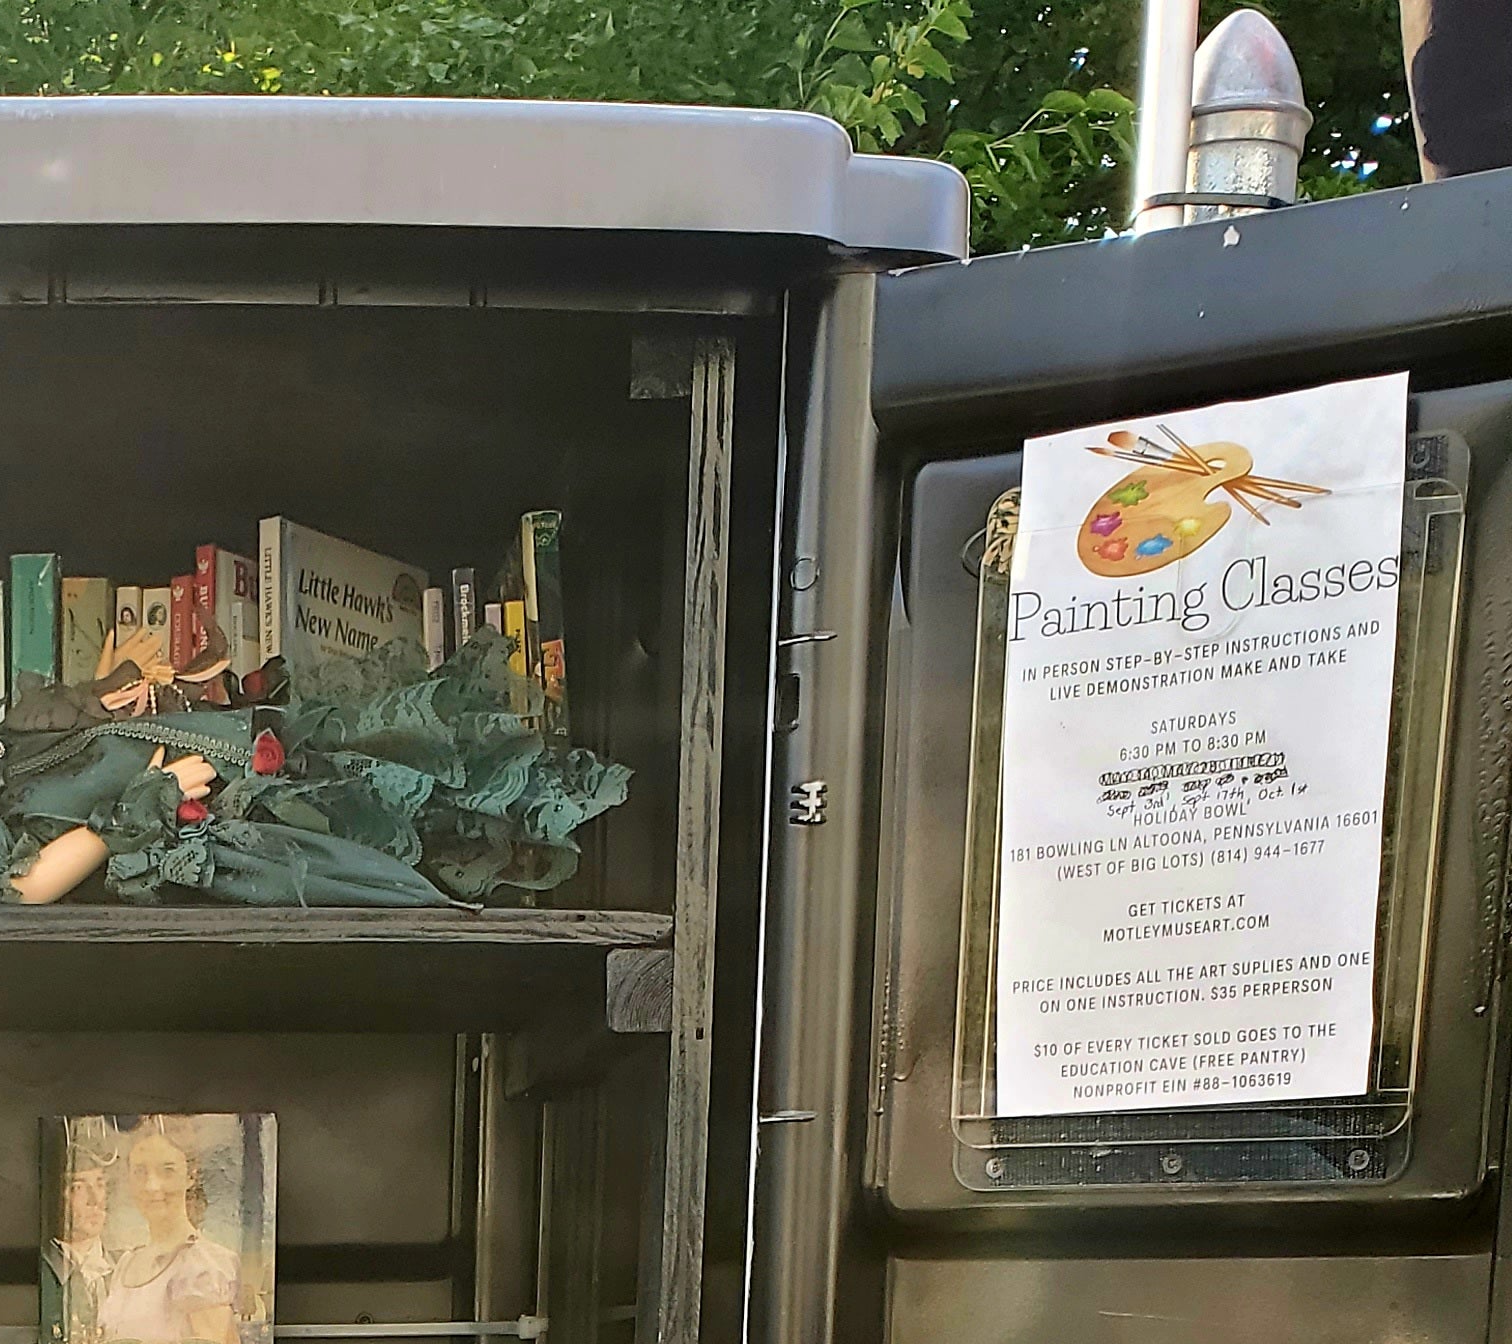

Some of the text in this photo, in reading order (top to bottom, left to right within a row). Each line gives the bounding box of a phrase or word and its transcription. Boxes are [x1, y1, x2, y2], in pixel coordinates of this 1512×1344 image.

[264, 547, 273, 653] LITTLE HAWK'S NEW
[299, 568, 337, 605] Little
[342, 584, 393, 624] Hawk's
[1009, 555, 1399, 642] Painting Classes
[295, 605, 378, 650] New Name
[1022, 621, 1380, 682] IN PERSON STEP-BY-STEP INSTRUCTIONS AND
[1049, 649, 1347, 701] LIVE DEMONSTRATION MAKE AND TAKE
[1151, 711, 1237, 734] SATURDAYS
[1120, 729, 1266, 761] 6:30 PM TO 8:30 PM
[1134, 803, 1247, 826] HOLIDAY BOWL
[1009, 810, 1378, 863] 181 BOWLING LN ALTOONA, PENNSYLVANIA 16601
[1057, 840, 1324, 882] (WEST OF BIG LOTS) (814) 944-1677
[1128, 894, 1245, 918] GET TICKETS AT
[1102, 914, 1270, 943] MOTLEYMUSEART.COM
[1013, 951, 1369, 994] PRICE INCLUDES ALL THE ART SUPLIES AND ONE
[1039, 977, 1332, 1014] ON ONE INSTRUCTION. $35 PERPERSON
[1034, 1023, 1336, 1058] $10 OF EVERY TICKET SOLD GOES TO THE
[1061, 1048, 1306, 1078] EDUCATION CAVE (FREE PANTRY)
[1073, 1071, 1291, 1099] NONPROFIT EIN #88-1063619
